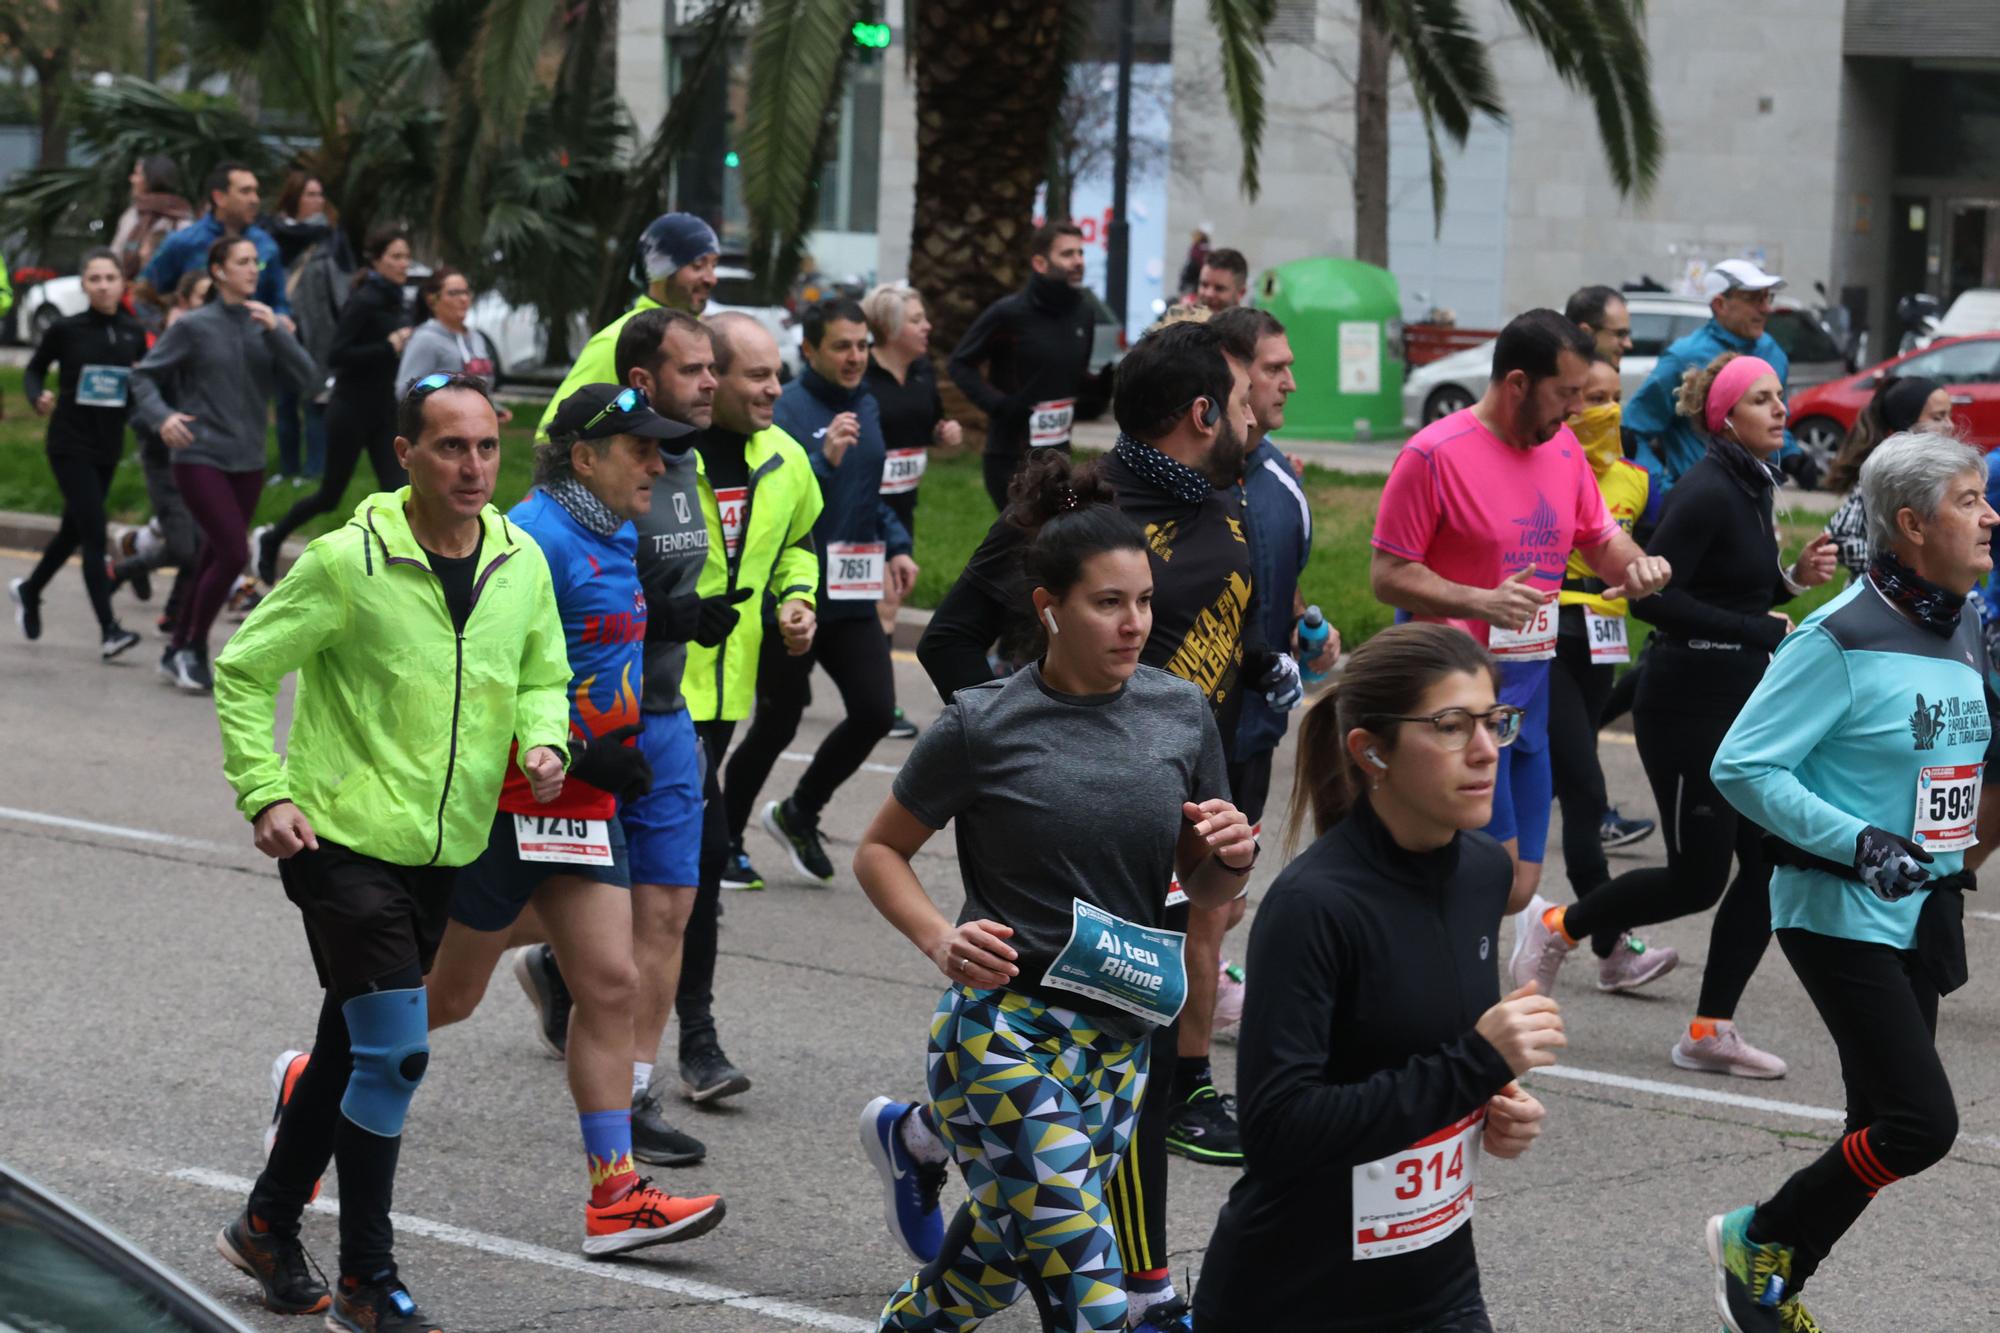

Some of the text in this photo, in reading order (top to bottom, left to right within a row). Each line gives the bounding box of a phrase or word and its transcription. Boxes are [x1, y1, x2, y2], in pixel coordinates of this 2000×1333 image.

[838, 558, 872, 579] 7651
[1168, 608, 1219, 680] VUELA
[1096, 929, 1121, 956] Al
[1123, 941, 1160, 968] teu
[1099, 956, 1163, 991] Ritme
[1394, 1140, 1464, 1200] 314
